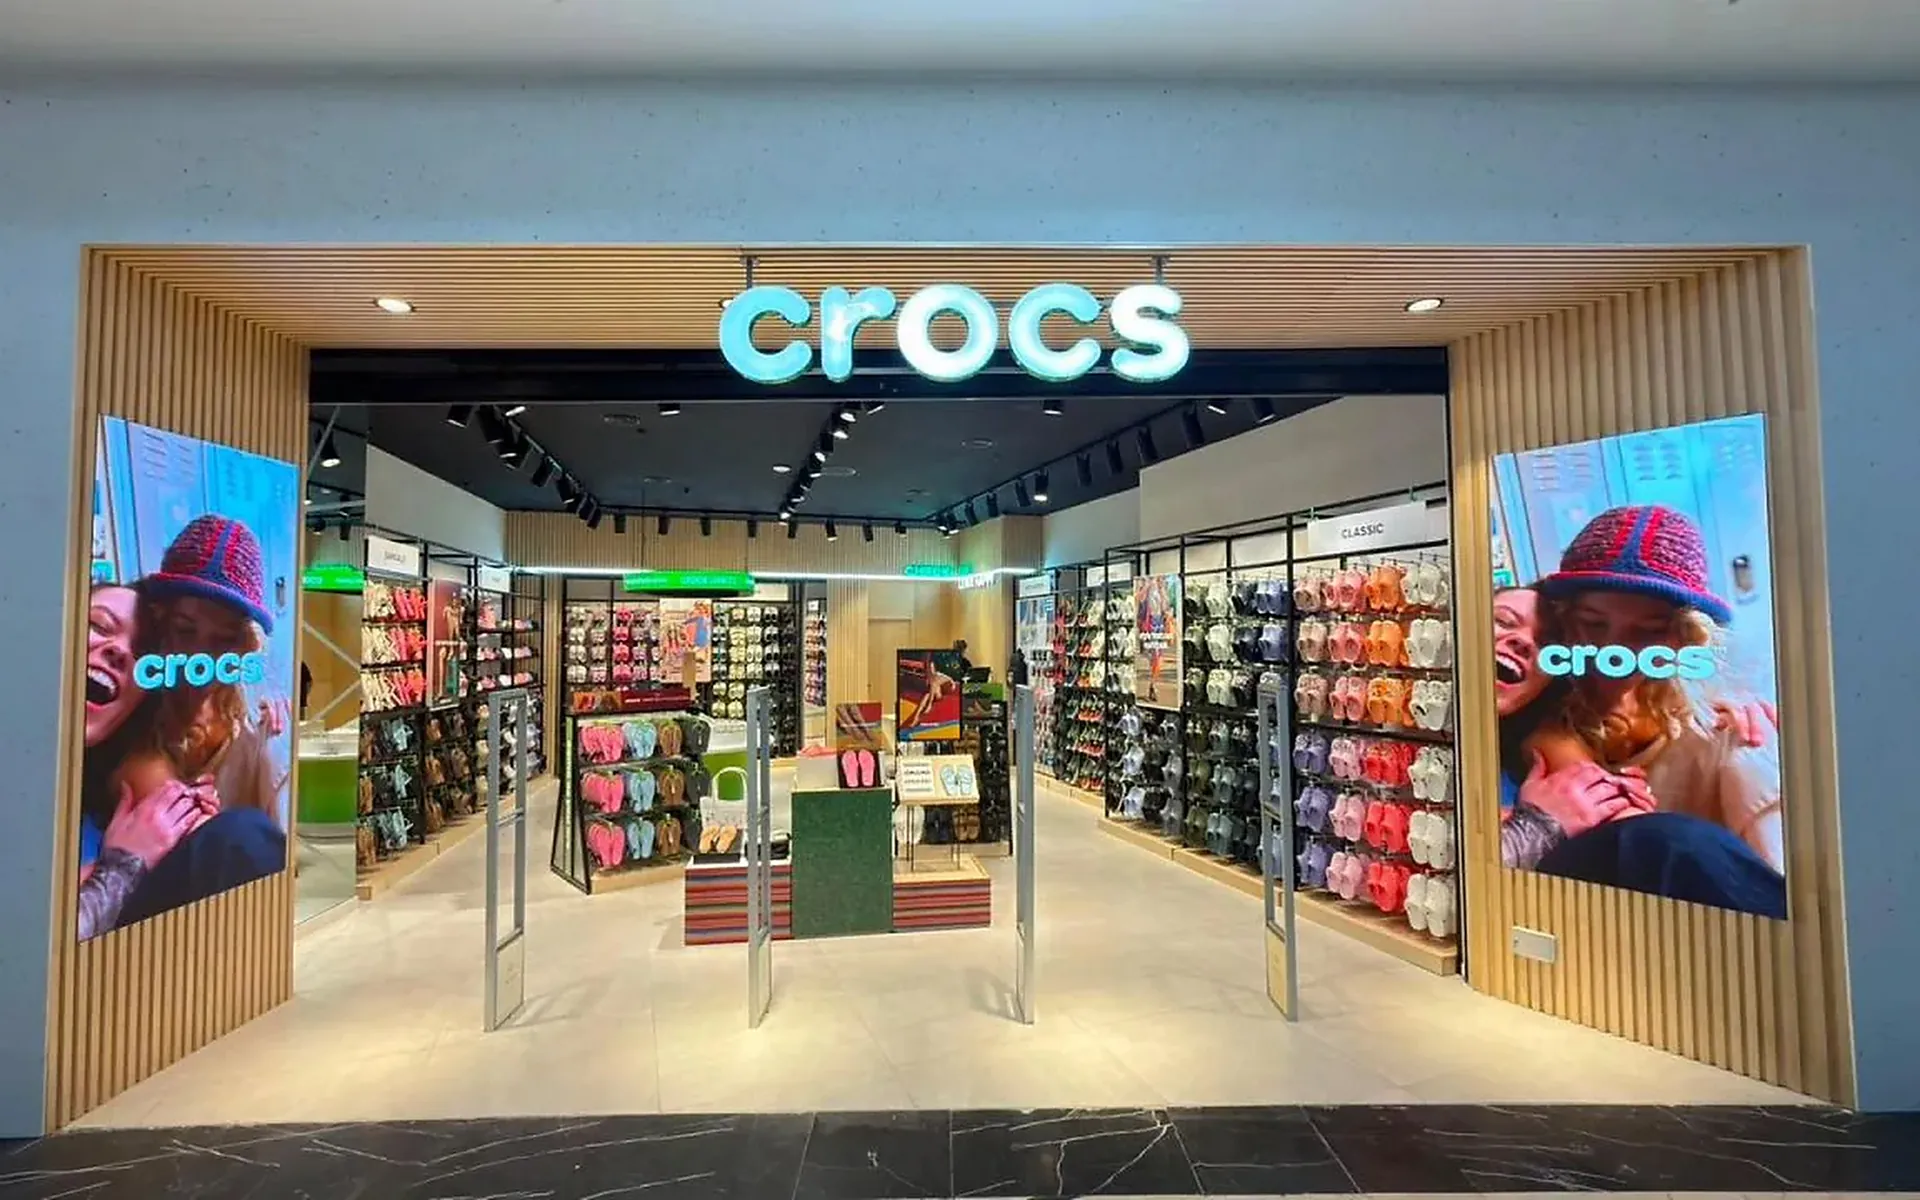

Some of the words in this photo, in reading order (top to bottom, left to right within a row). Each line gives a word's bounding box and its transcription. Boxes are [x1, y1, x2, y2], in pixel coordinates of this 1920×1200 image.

[719, 283, 1191, 383] crocs
[1341, 522, 1385, 539] CLASSIC
[132, 652, 264, 689] crocs
[1537, 645, 1716, 679] crocs
